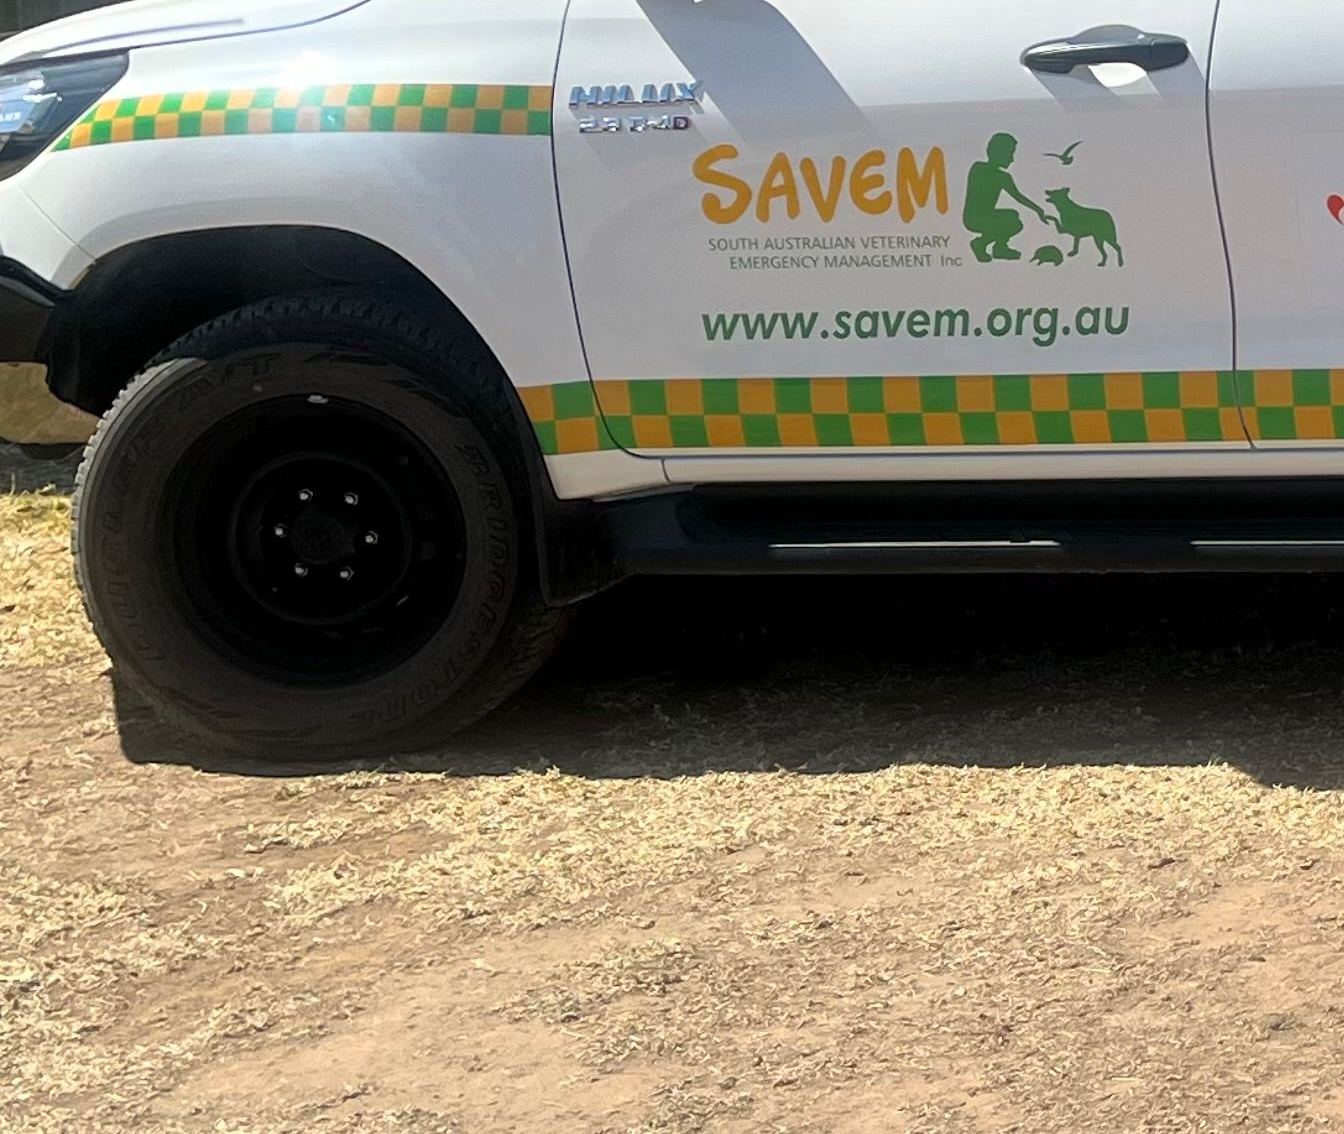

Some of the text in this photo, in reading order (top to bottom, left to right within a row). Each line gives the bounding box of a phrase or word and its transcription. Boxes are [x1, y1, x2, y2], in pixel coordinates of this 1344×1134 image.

[568, 81, 703, 107] HILUX
[692, 144, 949, 225] SAVEM
[708, 235, 951, 251] SOUTH AUSTRALIAN VETERINARY
[730, 254, 963, 270] EMERGENCY MANAGEMENT Inc
[701, 306, 1130, 347] www.savem.org.au
